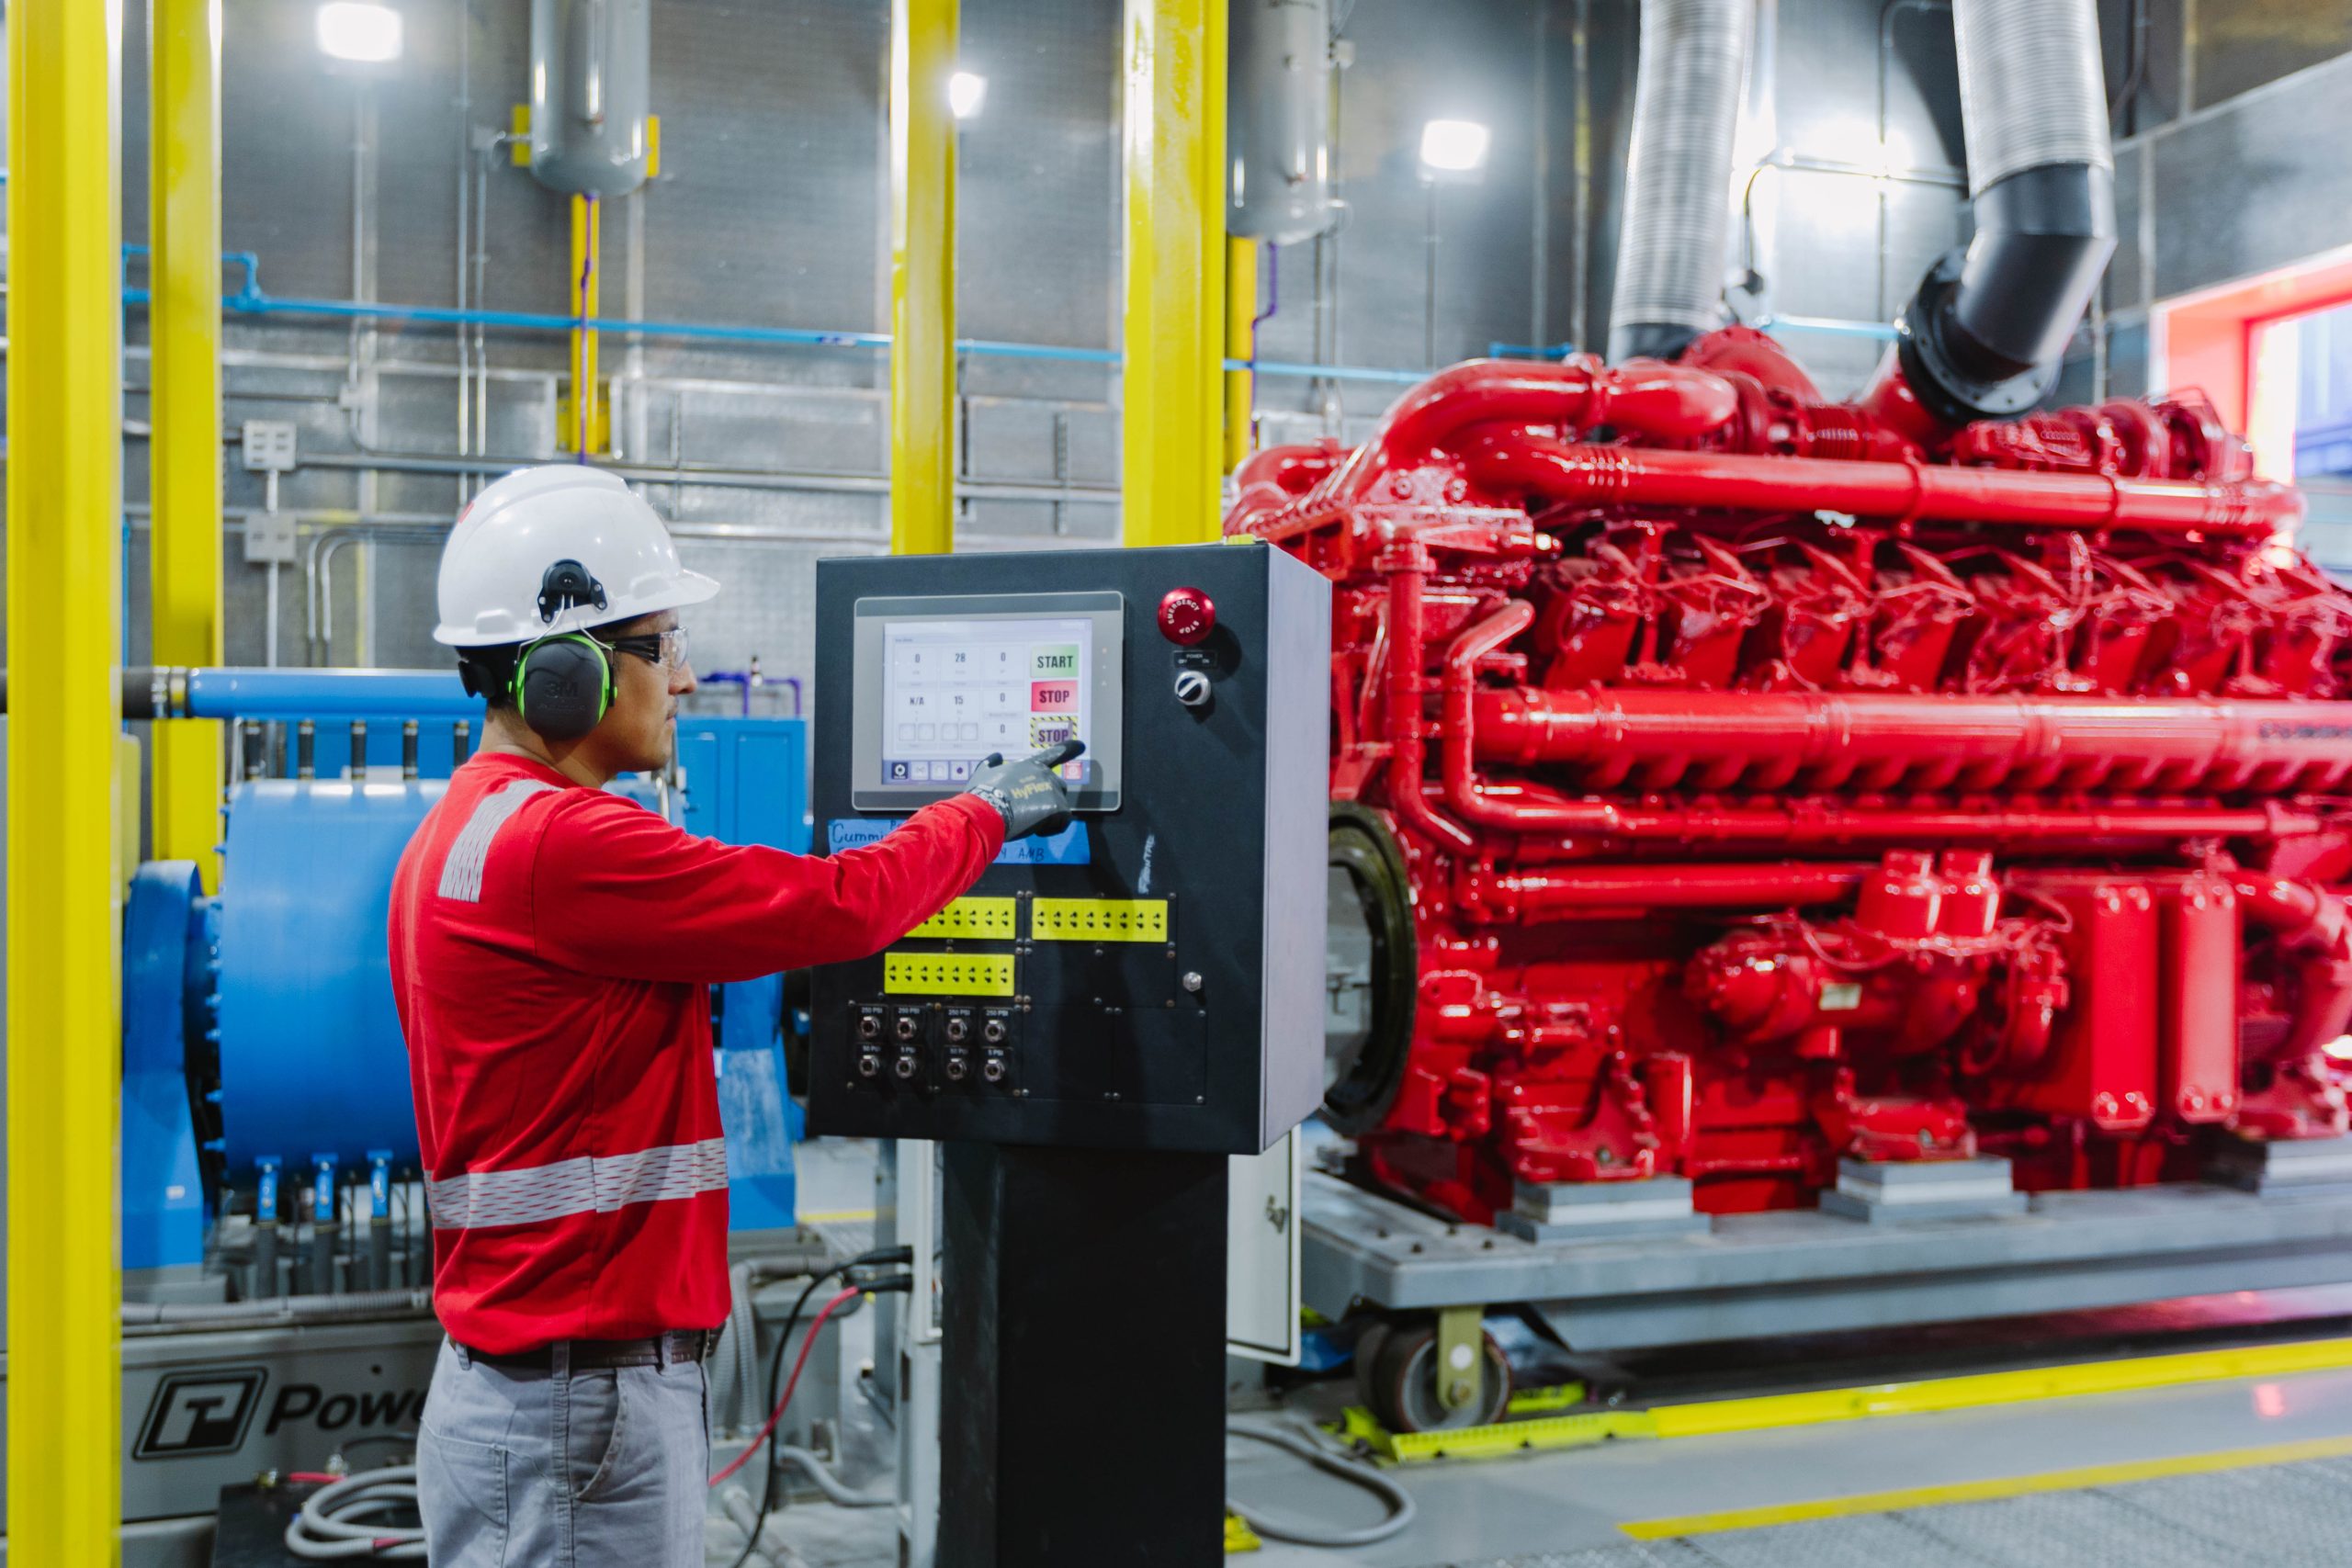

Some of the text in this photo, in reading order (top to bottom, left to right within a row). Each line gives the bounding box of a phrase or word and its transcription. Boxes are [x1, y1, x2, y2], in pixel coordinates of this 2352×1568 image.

[1167, 598, 1200, 625] EMERGENCY
[1179, 620, 1200, 634] STOP
[914, 653, 921, 663] 0
[956, 652, 966, 662] 28
[1001, 652, 1006, 661] 0
[1037, 655, 1073, 669] START
[955, 695, 964, 705] 15
[1000, 693, 1006, 703] 0
[1039, 690, 1069, 704] STOP
[1000, 724, 1006, 734] 0
[1038, 729, 1069, 743] STOP
[1010, 781, 1053, 799] HyFlex
